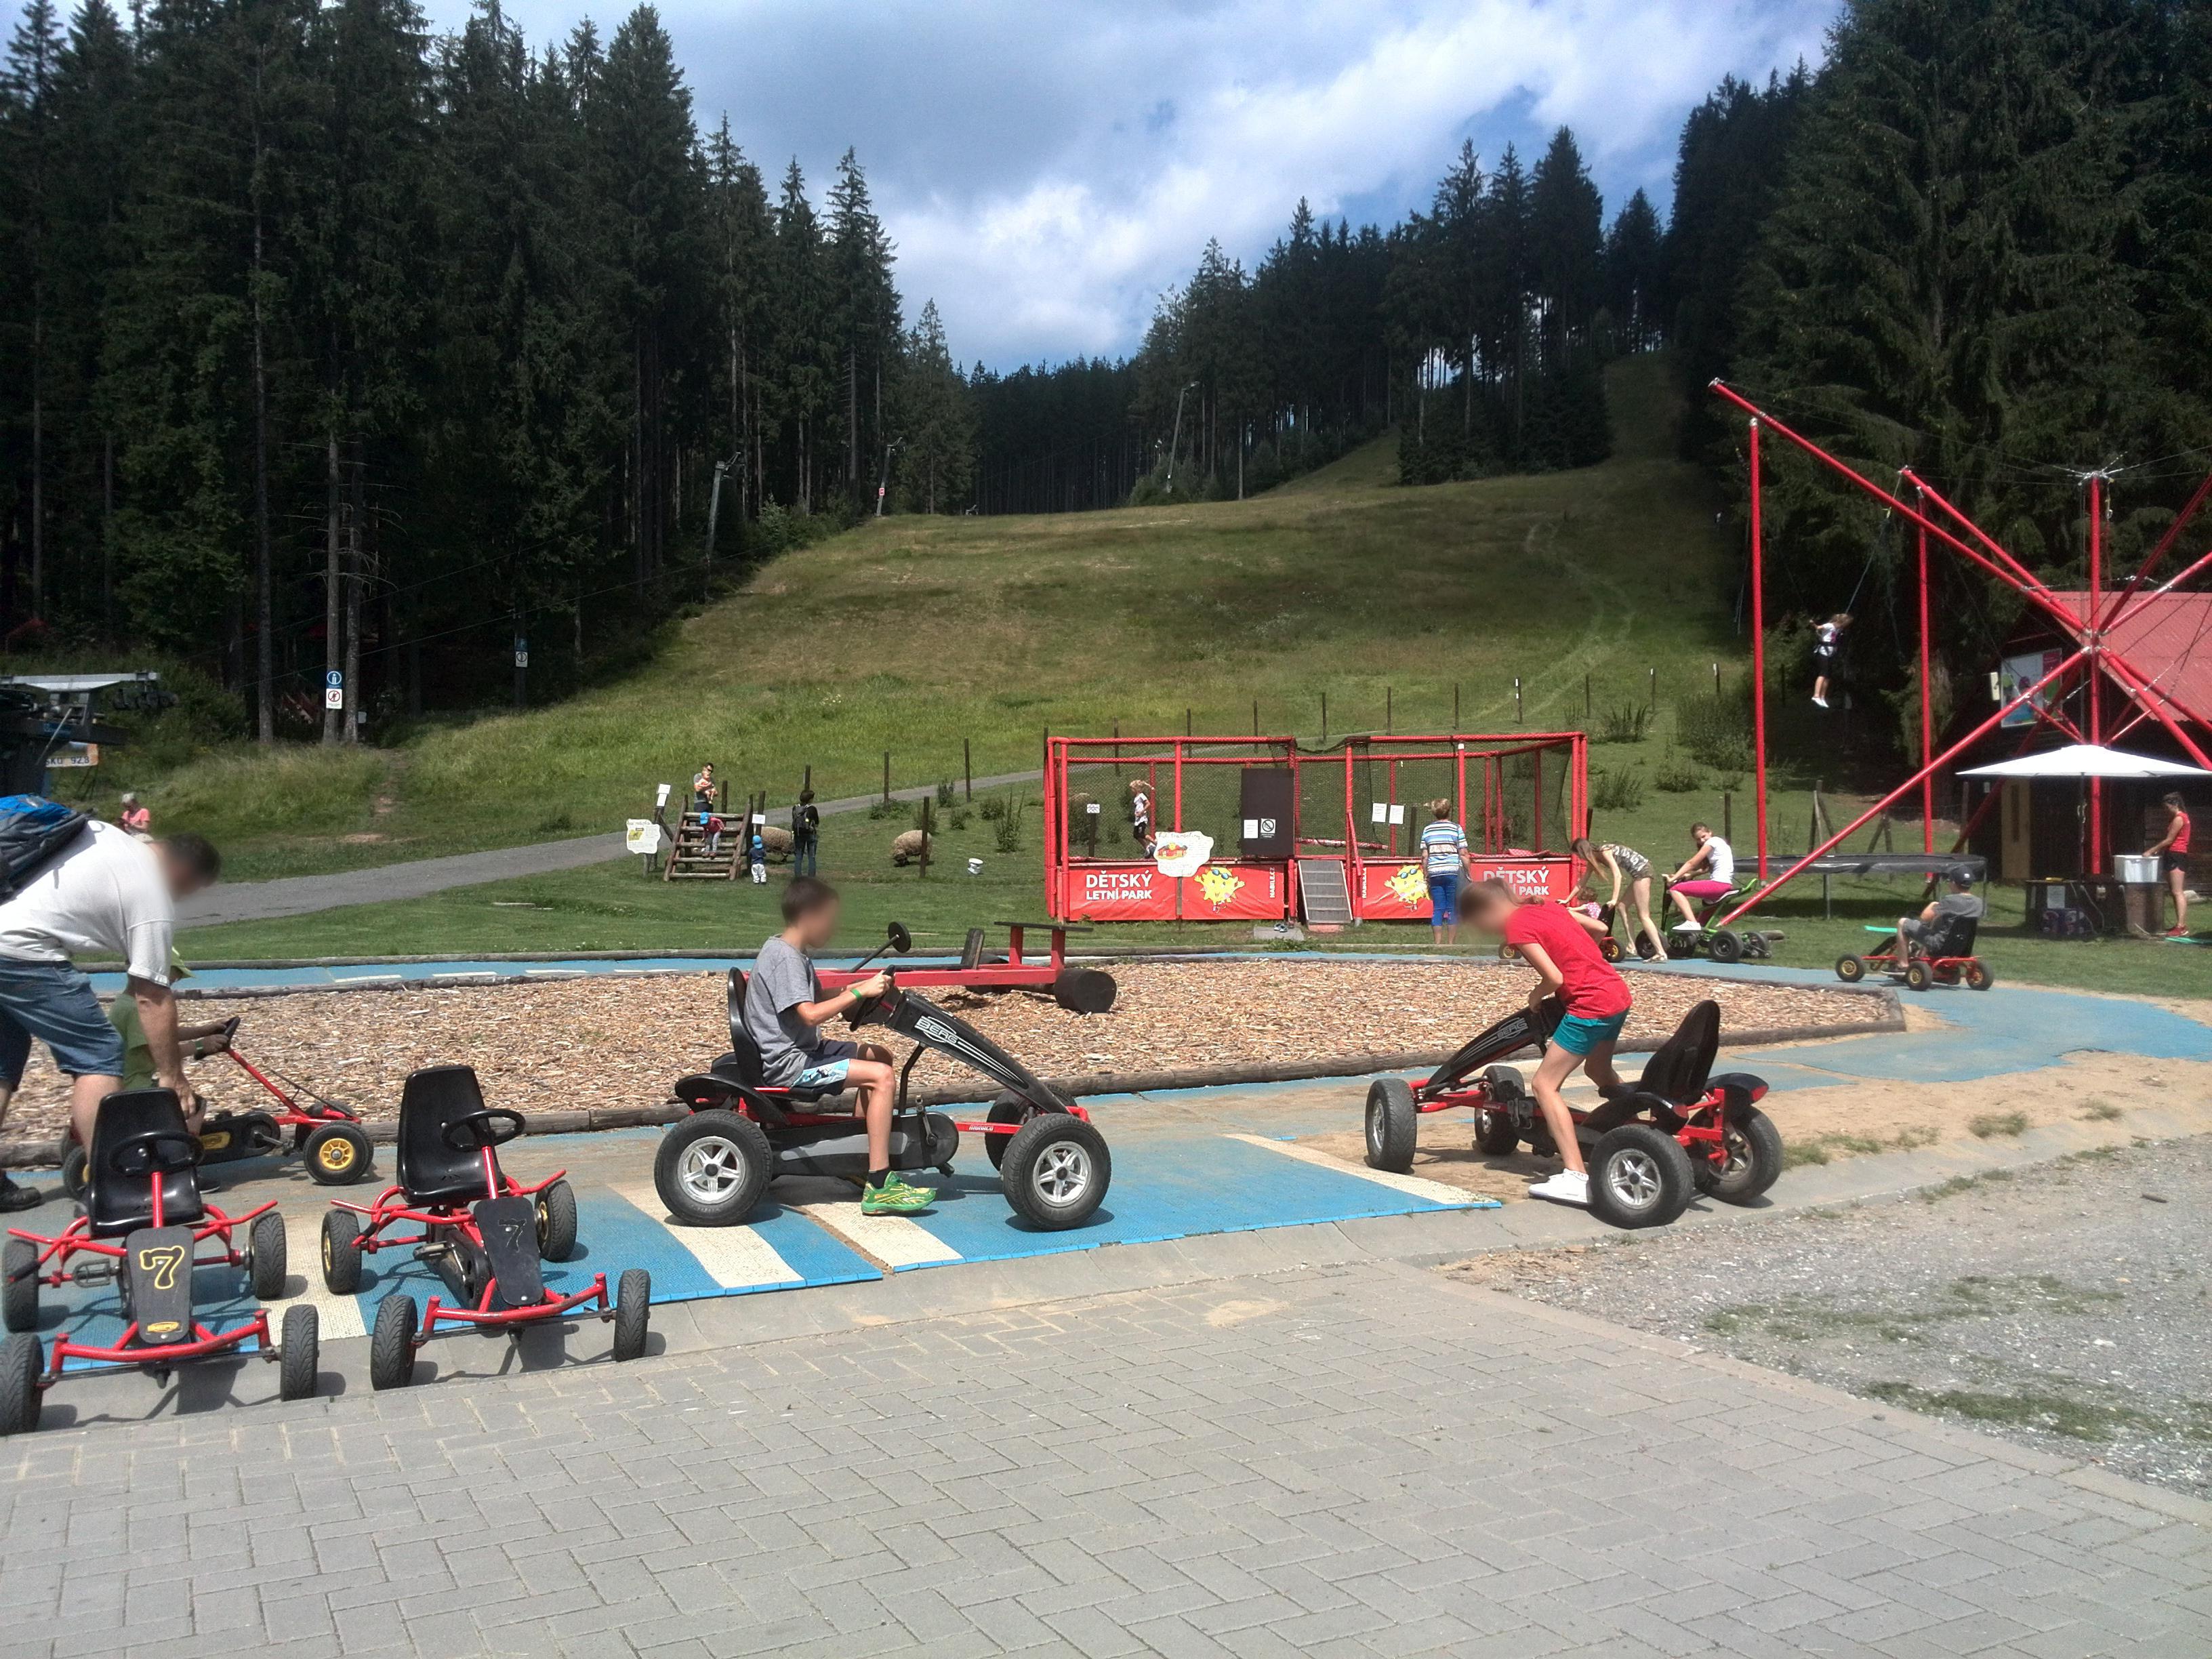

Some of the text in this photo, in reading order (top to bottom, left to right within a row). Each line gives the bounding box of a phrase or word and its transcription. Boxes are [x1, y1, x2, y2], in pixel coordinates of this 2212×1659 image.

[1086, 870, 1152, 888] DĚTSKÝ
[1519, 886, 1549, 895] PARK
[1086, 888, 1152, 900] LETNÍ PARK
[915, 1016, 958, 1044] BERG
[498, 1218, 527, 1253] 7
[140, 1246, 185, 1290] 7
